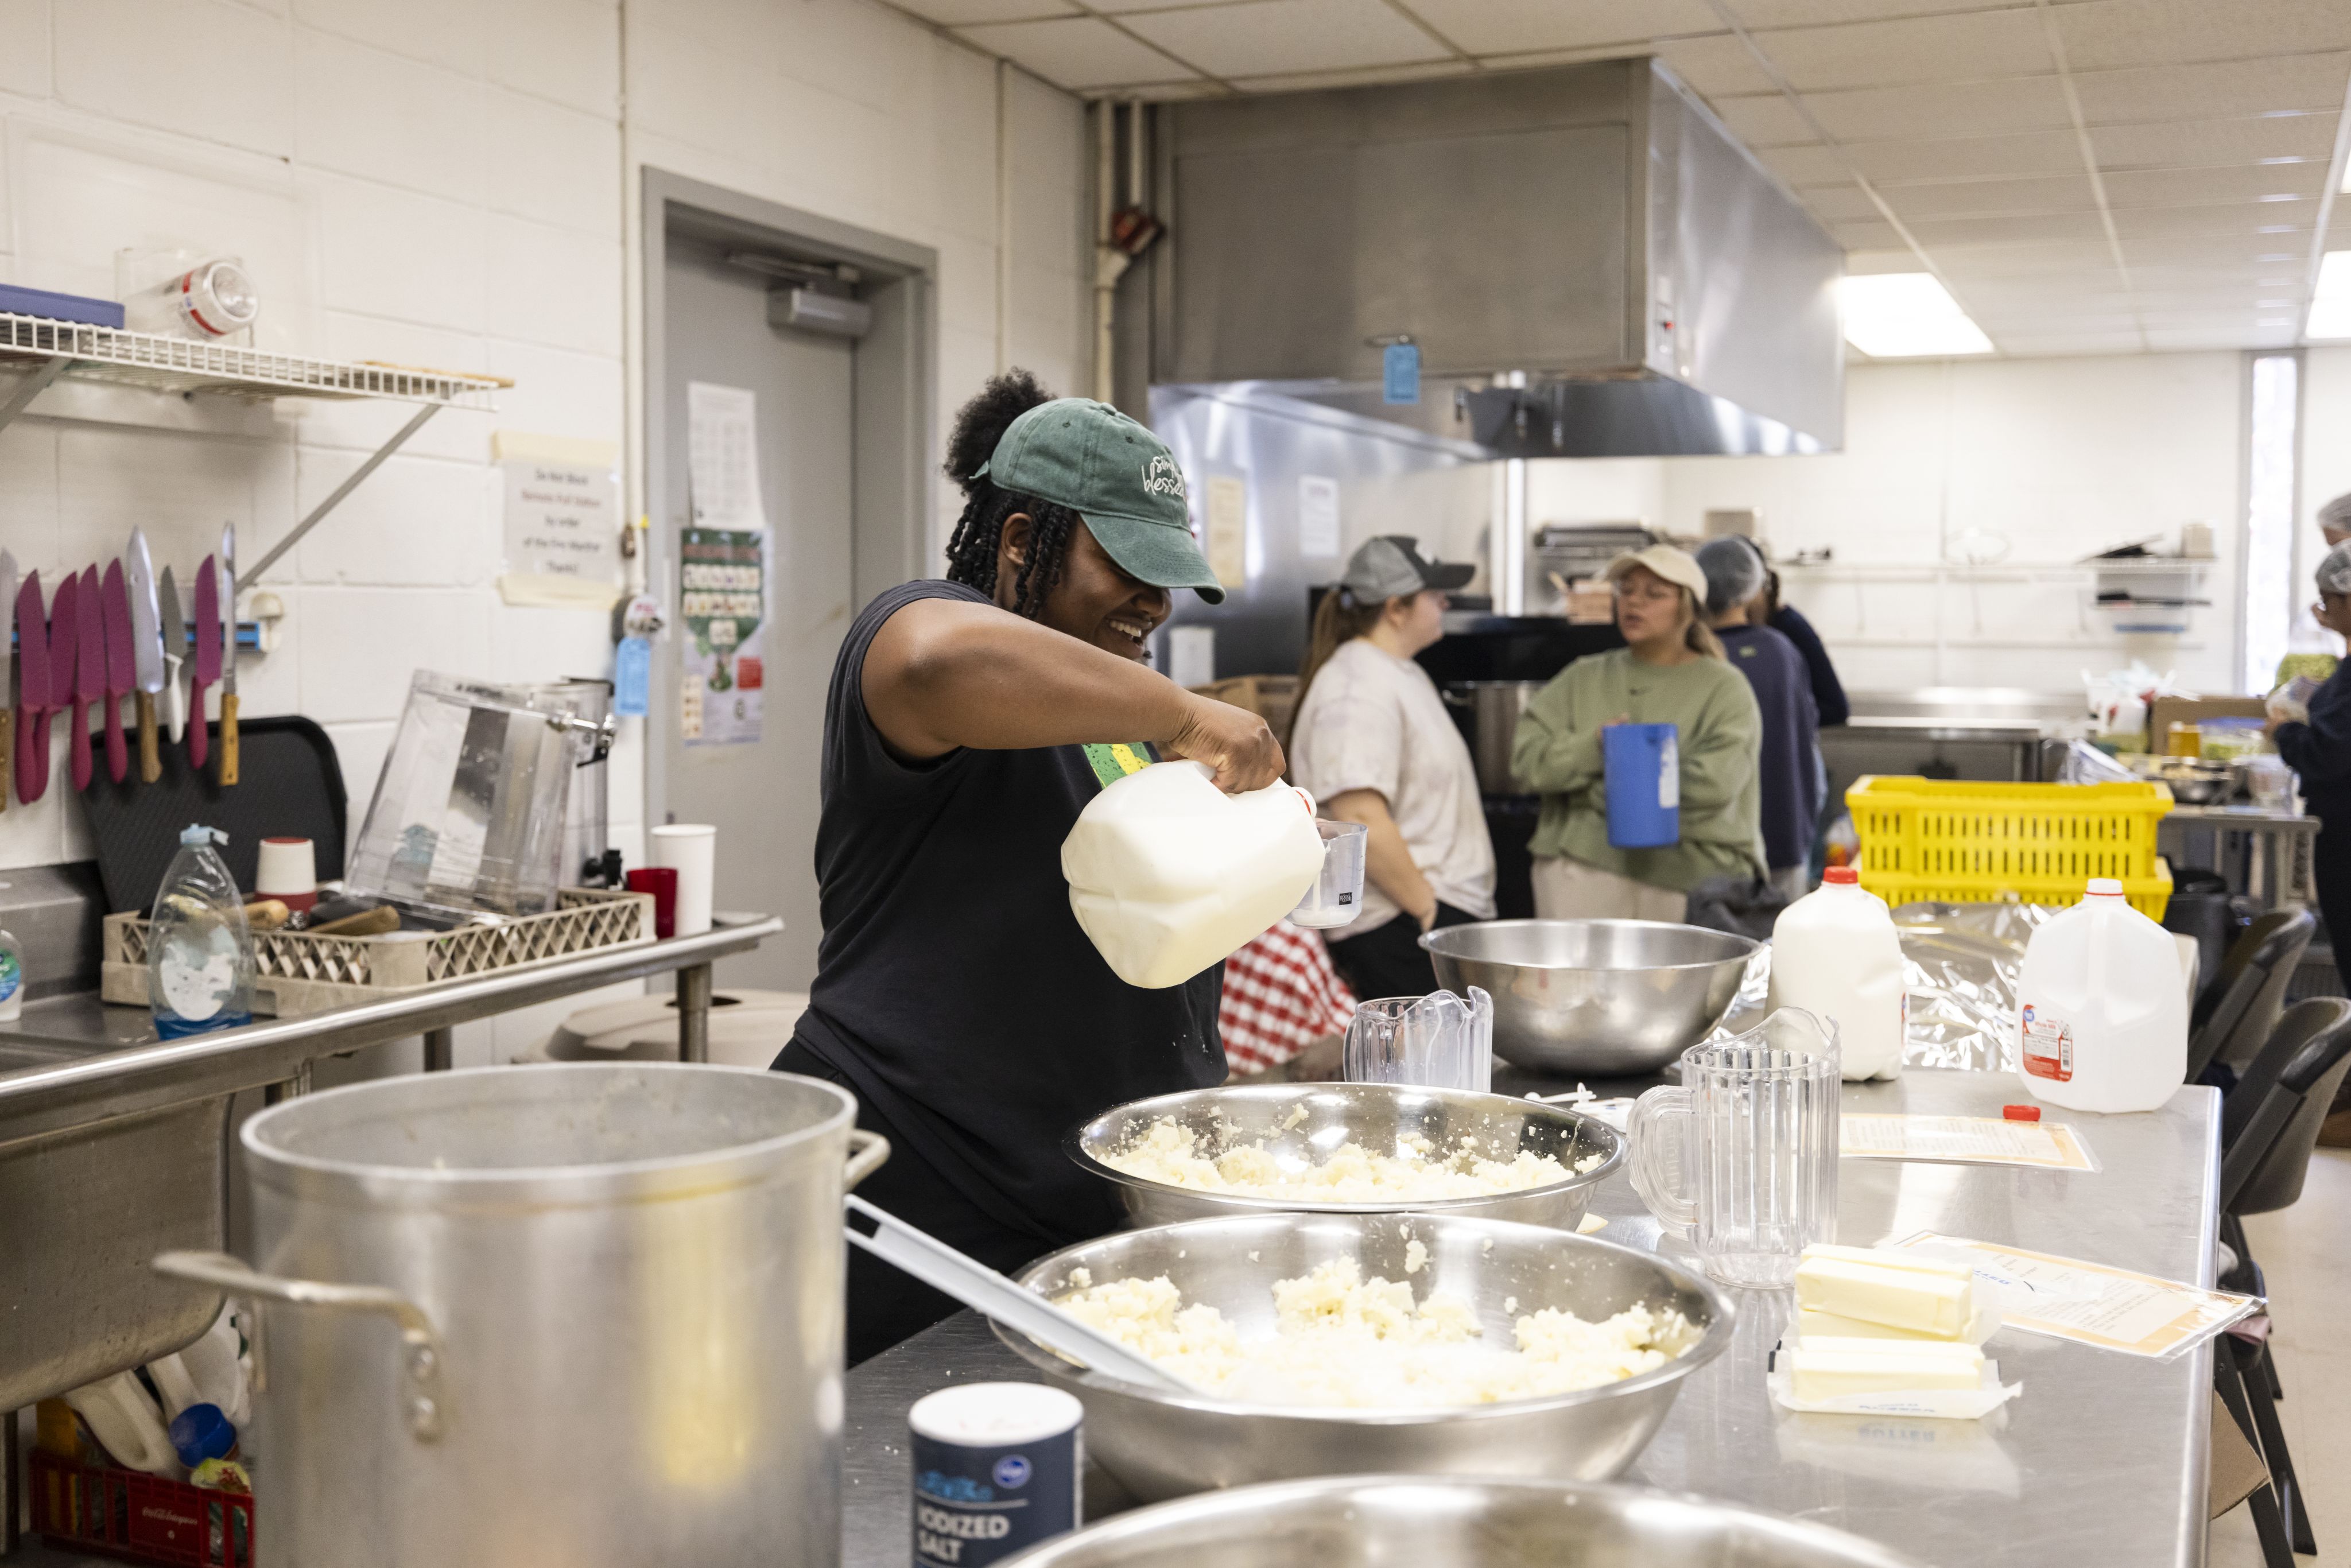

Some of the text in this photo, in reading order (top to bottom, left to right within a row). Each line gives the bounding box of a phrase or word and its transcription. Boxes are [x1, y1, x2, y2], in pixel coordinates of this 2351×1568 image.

[1340, 893, 1350, 901] good
[917, 1505, 1010, 1539] IODIZED
[918, 1529, 963, 1563] SALT
